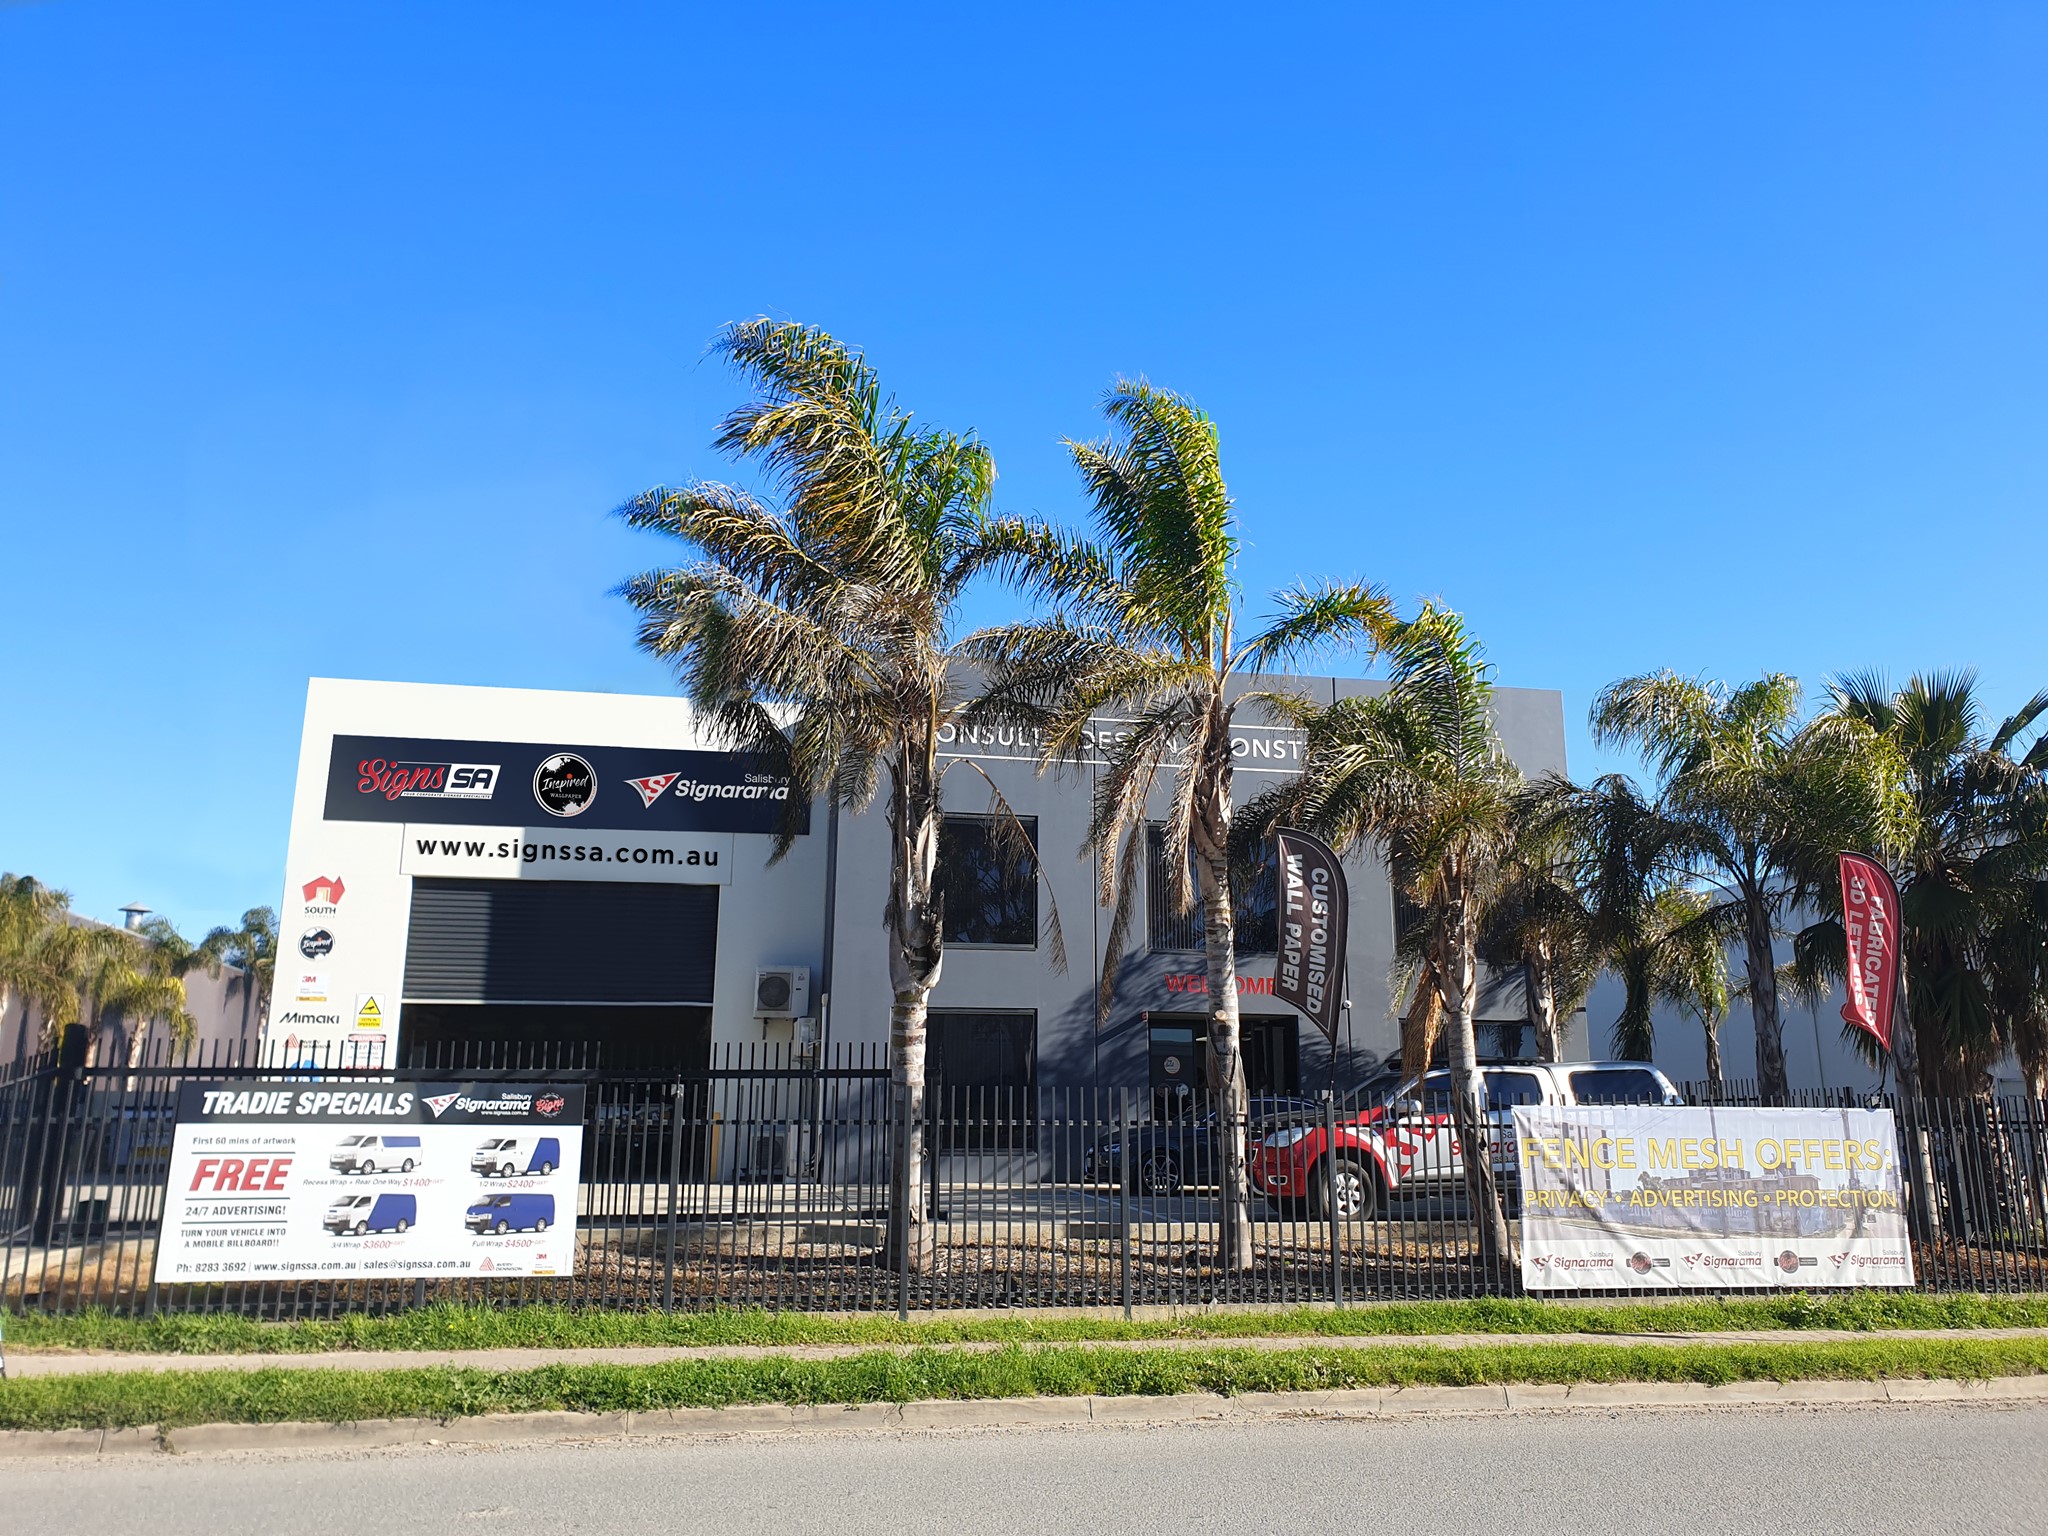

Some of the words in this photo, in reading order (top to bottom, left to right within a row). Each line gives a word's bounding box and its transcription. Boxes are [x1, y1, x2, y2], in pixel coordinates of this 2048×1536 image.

[935, 722, 1042, 746] ONSULT
[357, 758, 445, 800] Signs
[450, 768, 493, 789] SA
[541, 774, 589, 792] Inspired
[416, 839, 719, 866] www.signssa.com.au
[1286, 854, 1304, 916] WALL
[1850, 875, 1866, 904] 3D
[304, 906, 336, 915] SOUTH
[1306, 866, 1329, 1015] CUSTOMISED
[1281, 923, 1303, 993] PAPER
[1849, 910, 1864, 1007] LETTERS
[1864, 895, 1886, 1027] FABRICATED
[1165, 974, 1276, 996] WELOME
[202, 1091, 293, 1114] TRADIE
[295, 1092, 414, 1115] SPECIALS
[455, 1097, 531, 1113] Signarama
[501, 1092, 532, 1101] Salisbury
[192, 1137, 213, 1145] First
[215, 1137, 227, 1145] 60
[228, 1137, 249, 1145] mins
[252, 1137, 261, 1145] of
[263, 1137, 296, 1145] artwork
[1521, 1137, 1637, 1169] FENCE
[1648, 1137, 1745, 1170] MESH
[1755, 1138, 1892, 1170] OFFERS:
[189, 1158, 293, 1192] FREE
[1525, 1189, 1607, 1208] PRIVACY
[1629, 1189, 1758, 1208] ADVERTISING
[1775, 1189, 1897, 1208] PROTECTION
[185, 1206, 209, 1216] 24/7
[212, 1205, 286, 1216] ADVERTISING!
[180, 1229, 203, 1237] TURN
[230, 1228, 265, 1236] VEHICLE
[267, 1228, 286, 1236] INTO
[192, 1240, 224, 1248] MOBILE
[226, 1239, 279, 1247] BILLBOARD!!
[176, 1264, 192, 1273] Ph:
[195, 1263, 219, 1272] 8283
[222, 1263, 246, 1272] 3692
[254, 1261, 356, 1272] www.signssa.com.au
[363, 1259, 471, 1270] sales@signssa.com.au
[1554, 1257, 1614, 1270] Signarama
[1703, 1255, 1762, 1268] Signarama
[1851, 1254, 1906, 1267] Signarama
